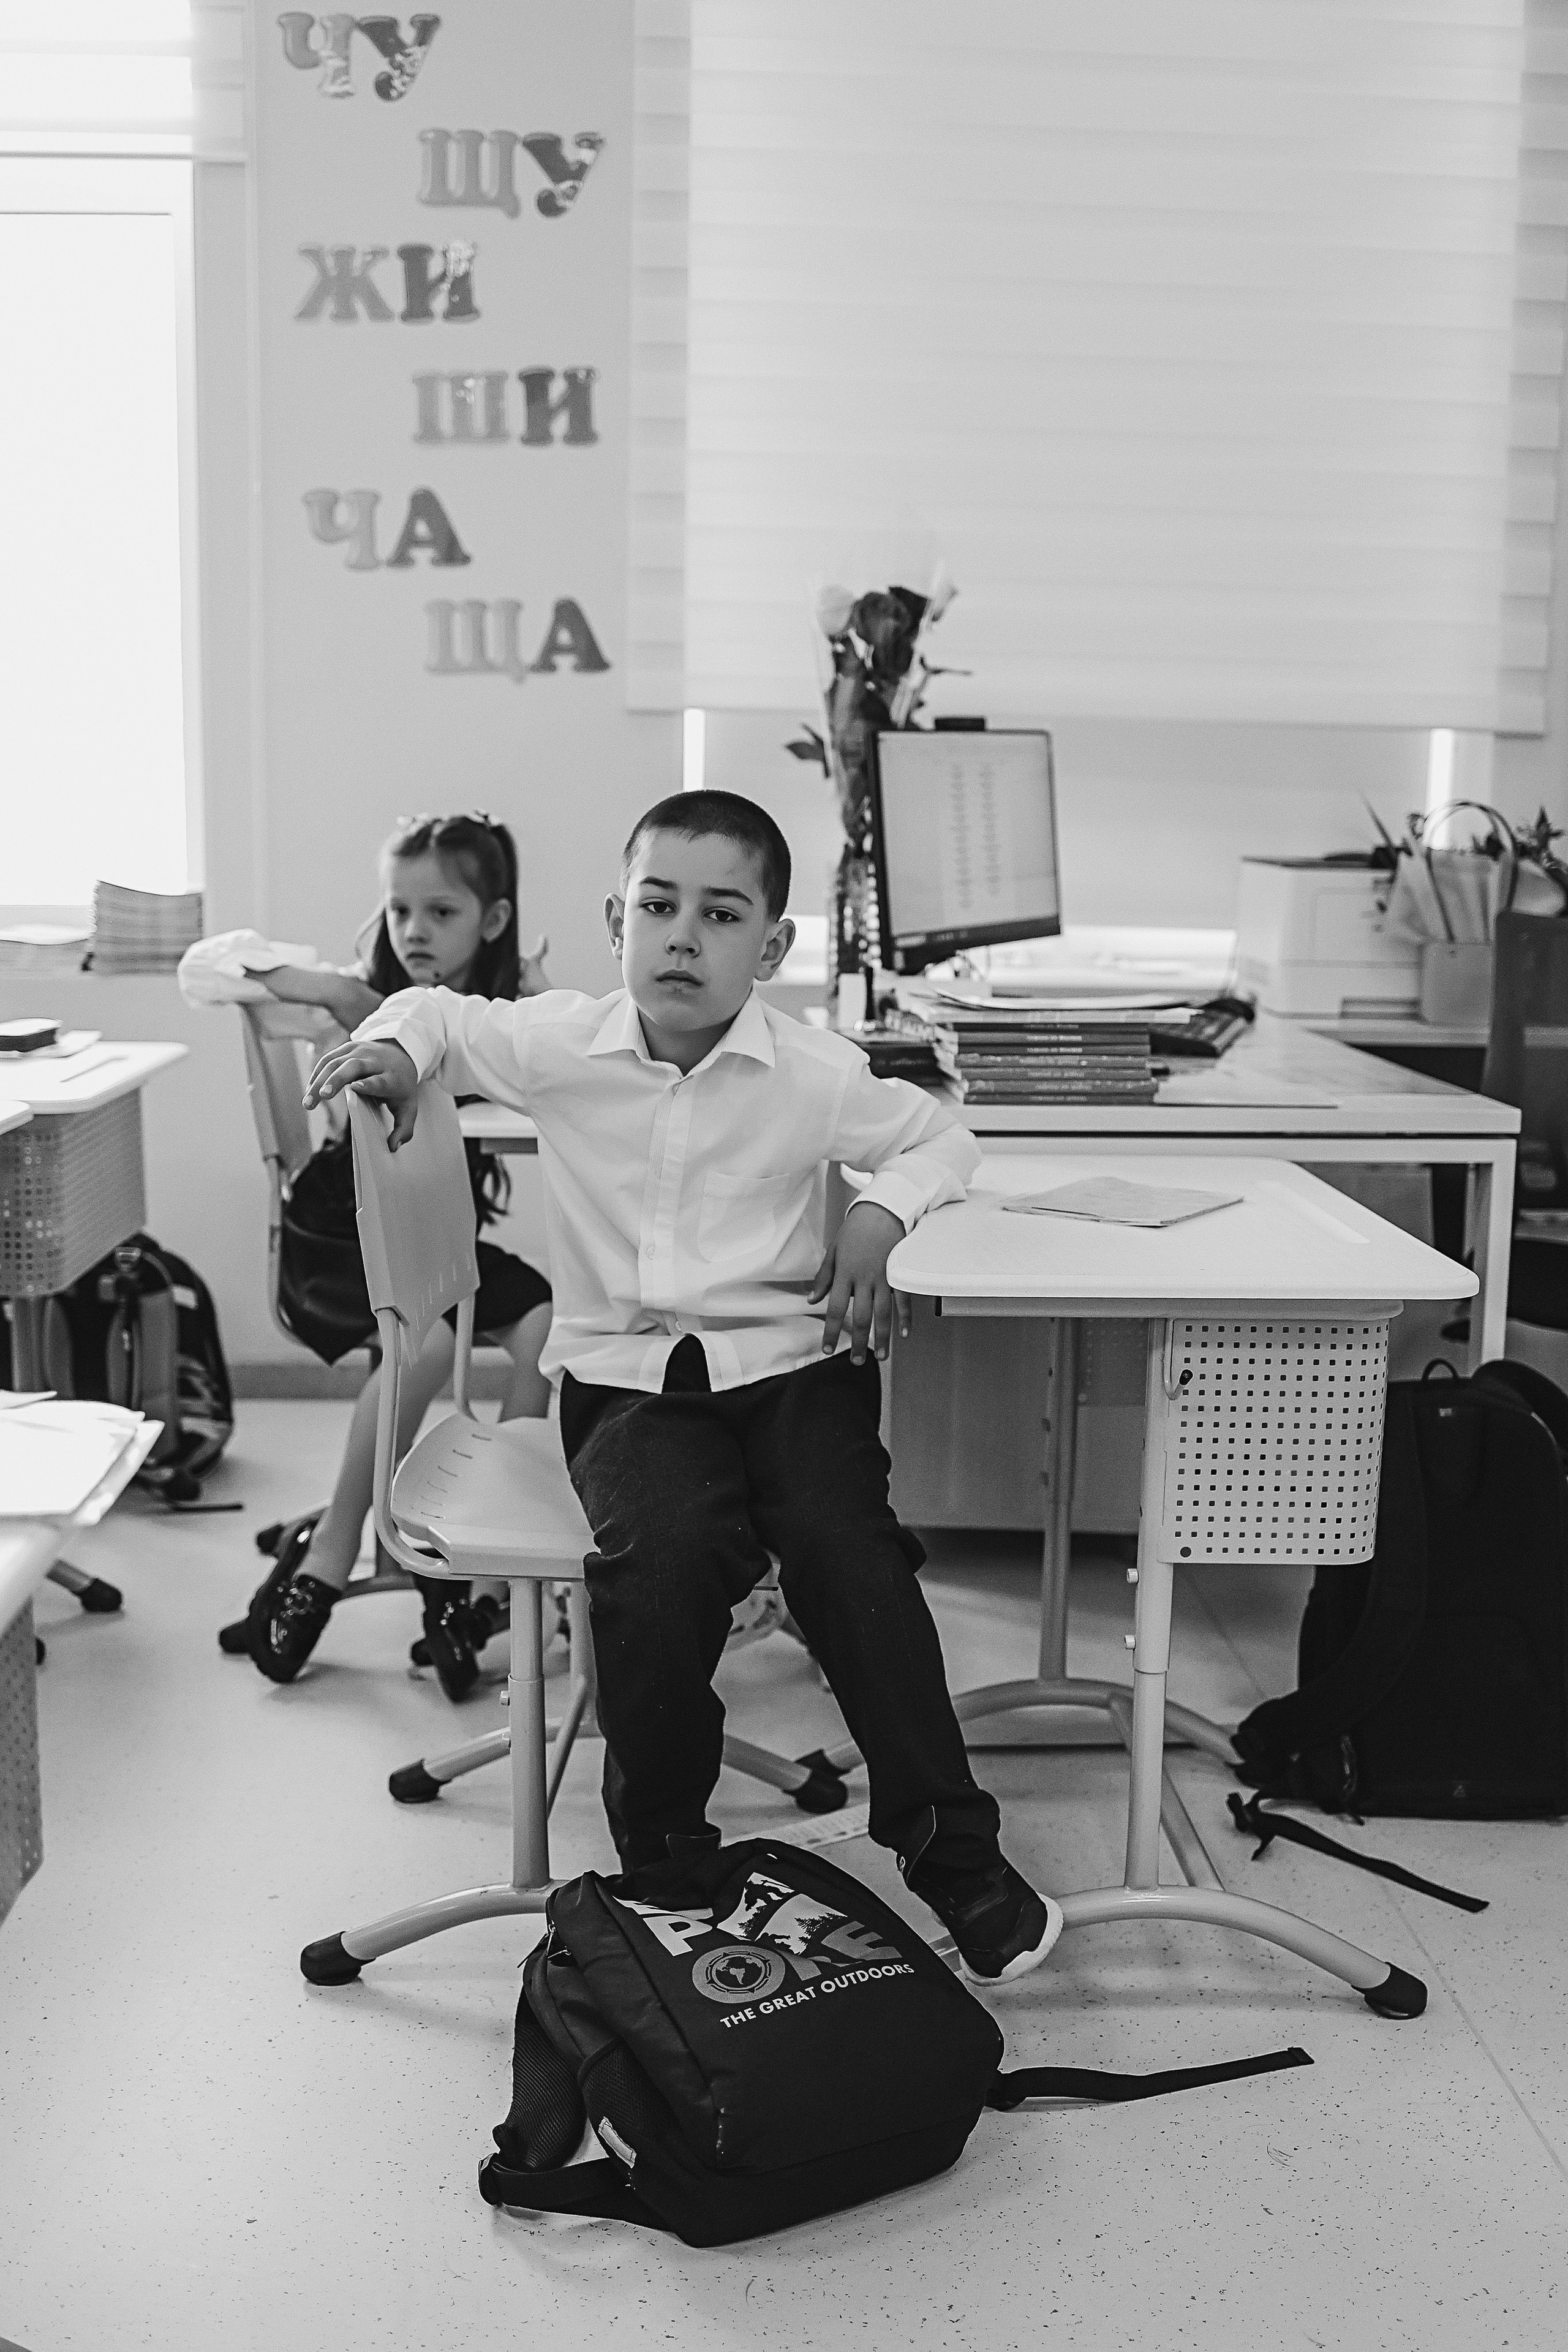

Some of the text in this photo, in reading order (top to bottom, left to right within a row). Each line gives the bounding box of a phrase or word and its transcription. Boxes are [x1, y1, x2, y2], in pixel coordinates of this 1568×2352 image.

[277, 12, 441, 101] ЧУ
[418, 128, 605, 219] ЩУ
[294, 241, 481, 324] ЖИ
[412, 366, 600, 447] ШИ
[302, 486, 472, 572] ЧА
[424, 597, 612, 685] ЩА
[720, 1963, 915, 2028] THE GREAT OUTDOORS
